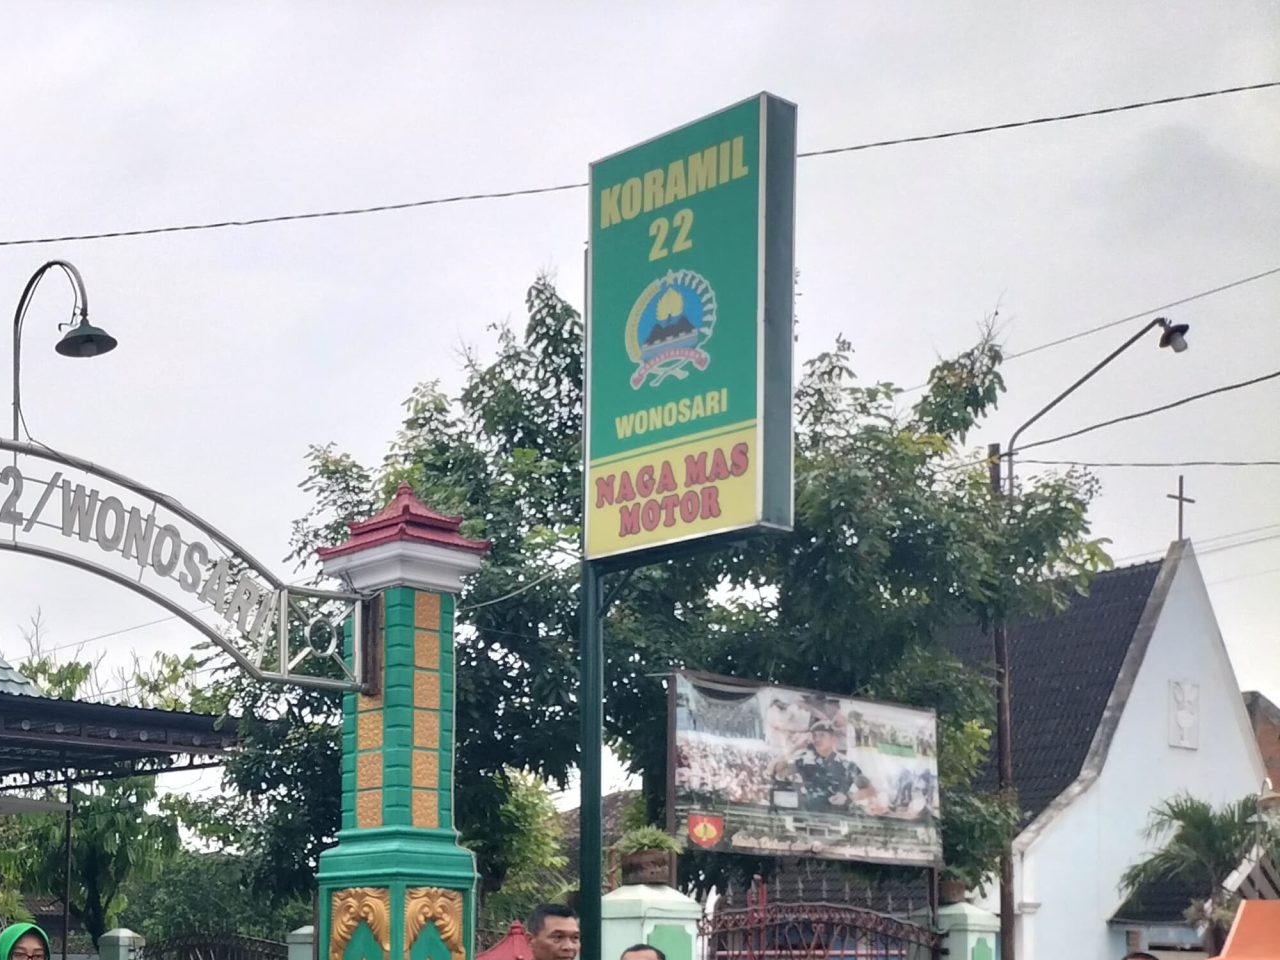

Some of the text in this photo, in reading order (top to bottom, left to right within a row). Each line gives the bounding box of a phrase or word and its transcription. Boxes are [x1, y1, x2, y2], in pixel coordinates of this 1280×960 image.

[600, 136, 749, 230] KORAMIL
[648, 208, 694, 262] 22
[615, 388, 728, 439] WONOSARI
[595, 442, 749, 509] NAGA MAS
[618, 485, 722, 538] MOTOR
